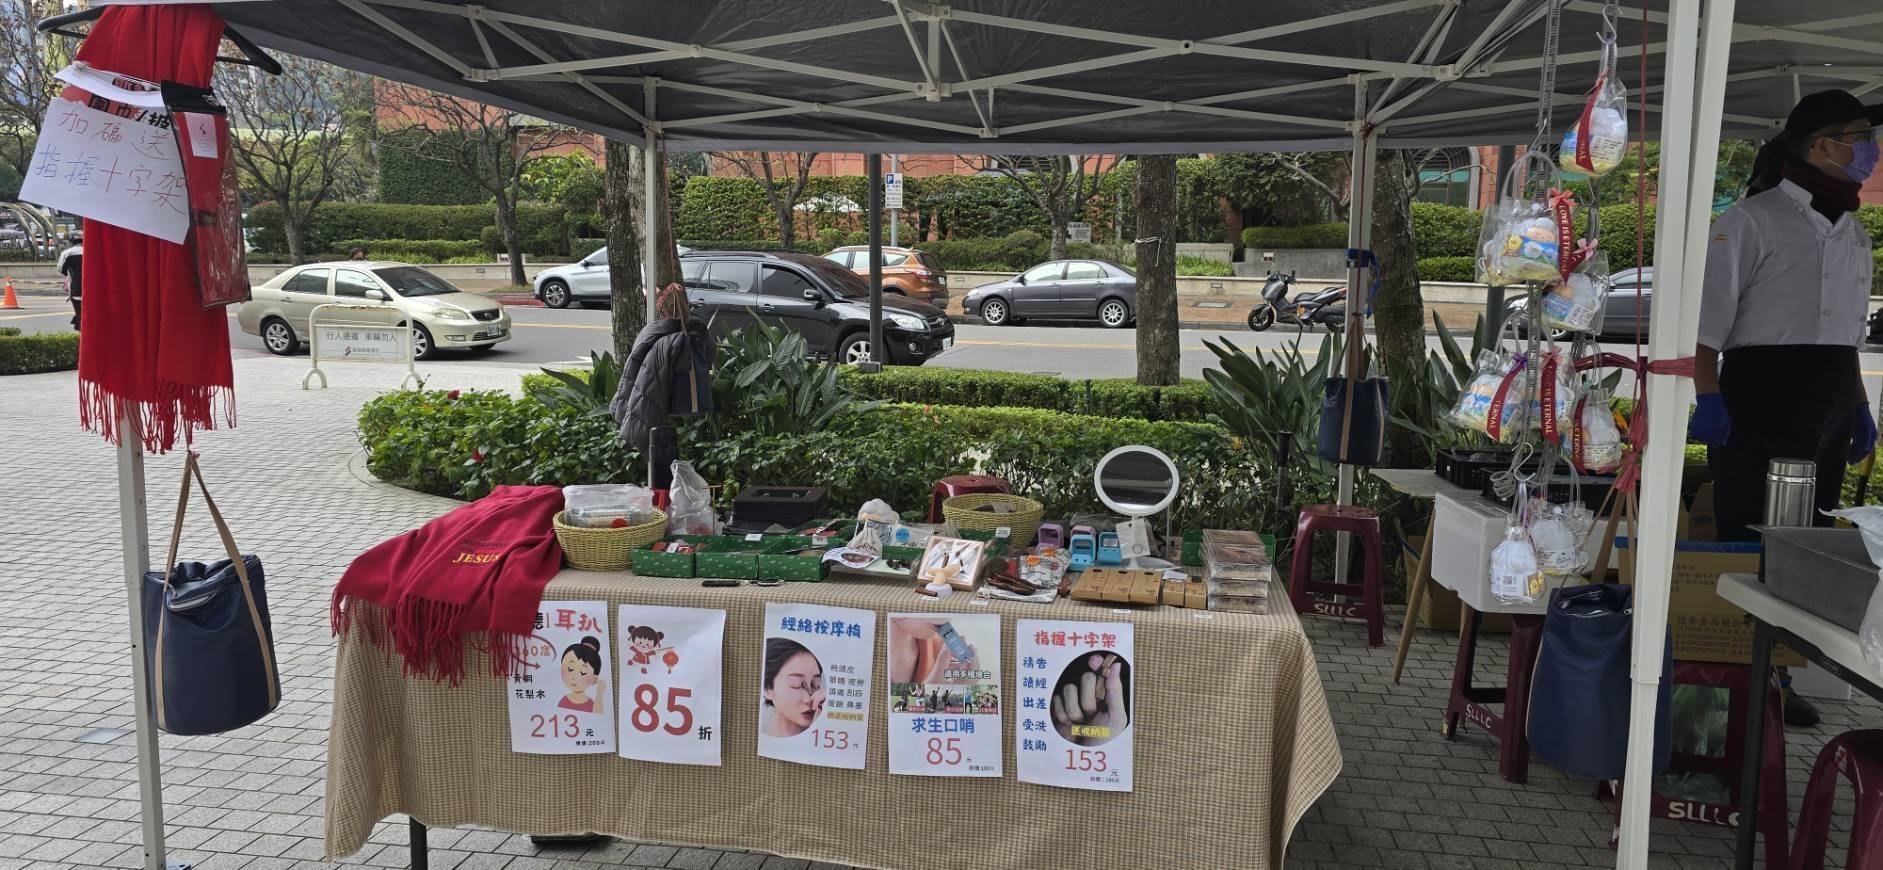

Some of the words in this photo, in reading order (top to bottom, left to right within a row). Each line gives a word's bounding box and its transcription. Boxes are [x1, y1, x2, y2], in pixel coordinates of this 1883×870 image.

[58, 109, 174, 160] 加碼送
[34, 143, 188, 214] 指握十字架
[1562, 226, 1570, 234] IS
[1544, 397, 1553, 434] ETERNAL
[781, 616, 862, 639] 經絡按摩梳
[1034, 630, 1117, 648] 指握十字架
[1022, 656, 1048, 670] 禱告
[515, 688, 546, 699] 花梨木
[1022, 677, 1047, 690] 讀經
[631, 683, 694, 736] 85
[698, 725, 713, 741] 折
[1023, 697, 1047, 710] 出差
[530, 714, 580, 738] 213
[911, 717, 975, 734] 求生口哨
[1022, 718, 1047, 732] 受洗
[1465, 703, 1492, 729] SLLLC
[811, 728, 849, 750] 153
[926, 737, 962, 765] 85
[1065, 749, 1107, 772] 153
